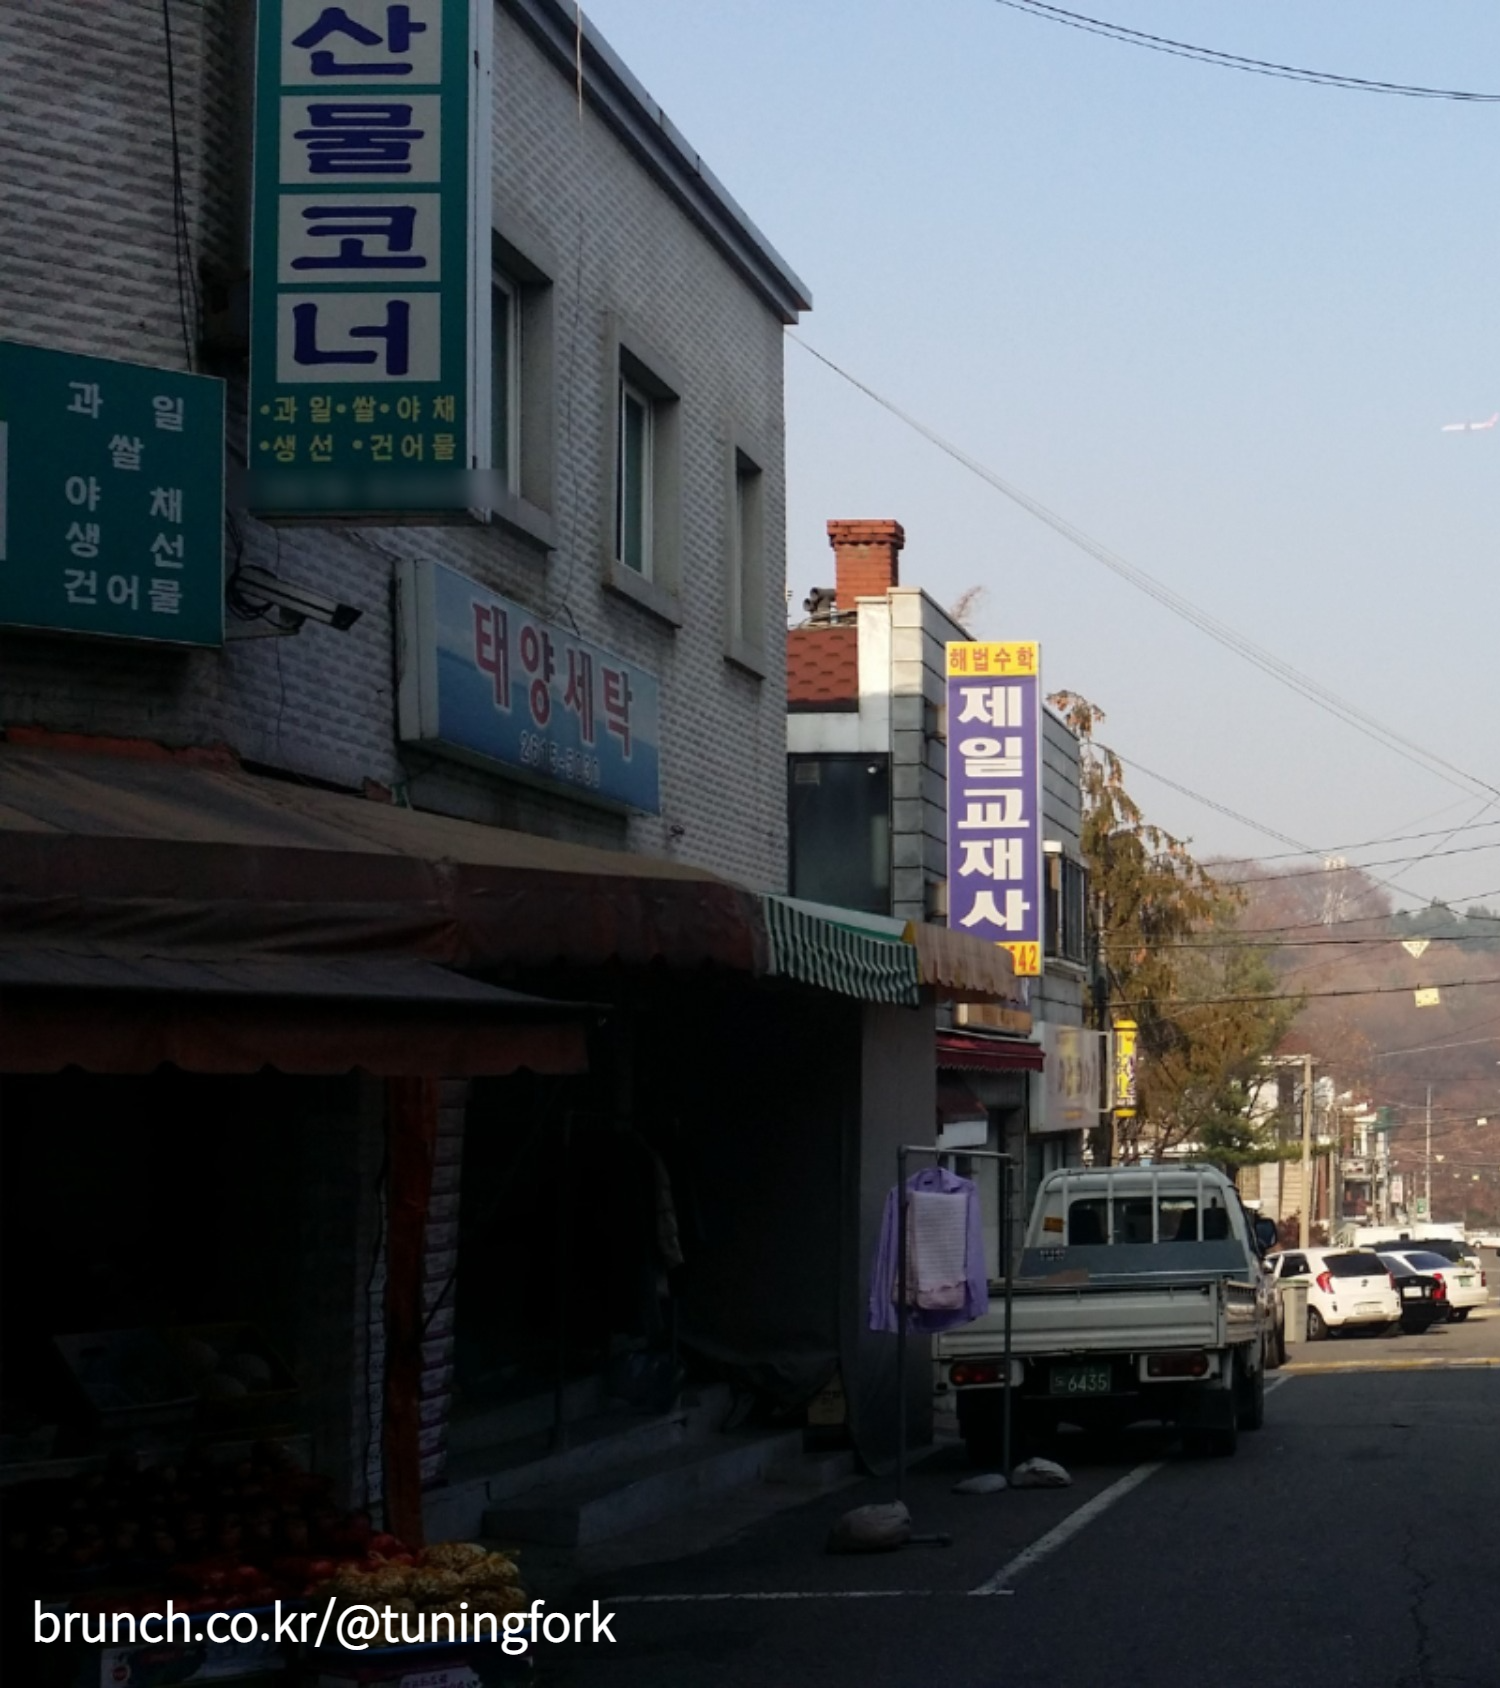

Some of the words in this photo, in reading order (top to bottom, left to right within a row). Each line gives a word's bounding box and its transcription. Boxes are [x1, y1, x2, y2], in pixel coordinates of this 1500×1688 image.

[108, 434, 144, 472] 쌀
[64, 568, 182, 615] 건어물
[472, 602, 633, 758] 태양세탁
[950, 646, 1034, 672] 해법수학
[957, 685, 1030, 932] 제일교재사
